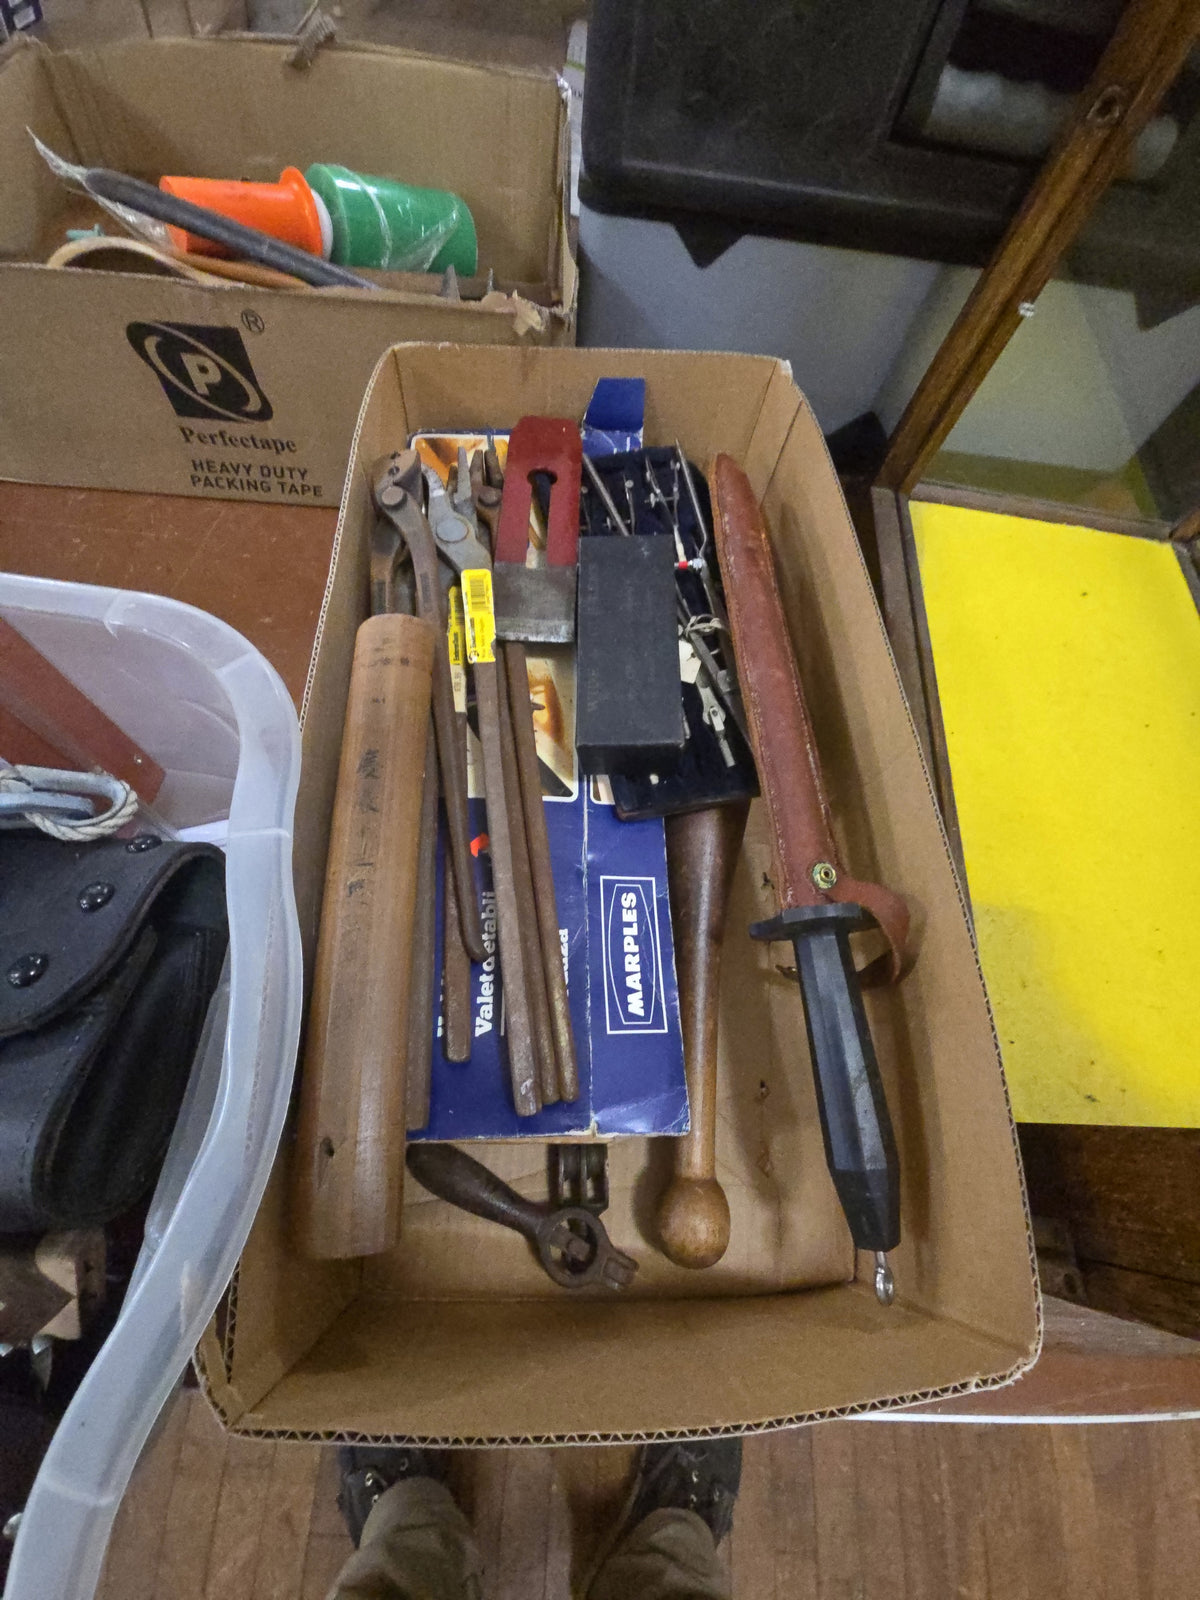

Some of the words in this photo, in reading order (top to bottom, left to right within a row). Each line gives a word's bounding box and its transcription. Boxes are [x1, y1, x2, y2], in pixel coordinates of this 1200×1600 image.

[180, 352, 222, 396] P
[179, 426, 298, 455] Perfectape
[190, 475, 271, 492] PACKING
[280, 483, 323, 497] TAPE
[191, 459, 252, 475] HEAVY
[260, 465, 308, 480] DUTY
[621, 892, 644, 1016] MARPLES
[474, 973, 494, 1037] Valet
